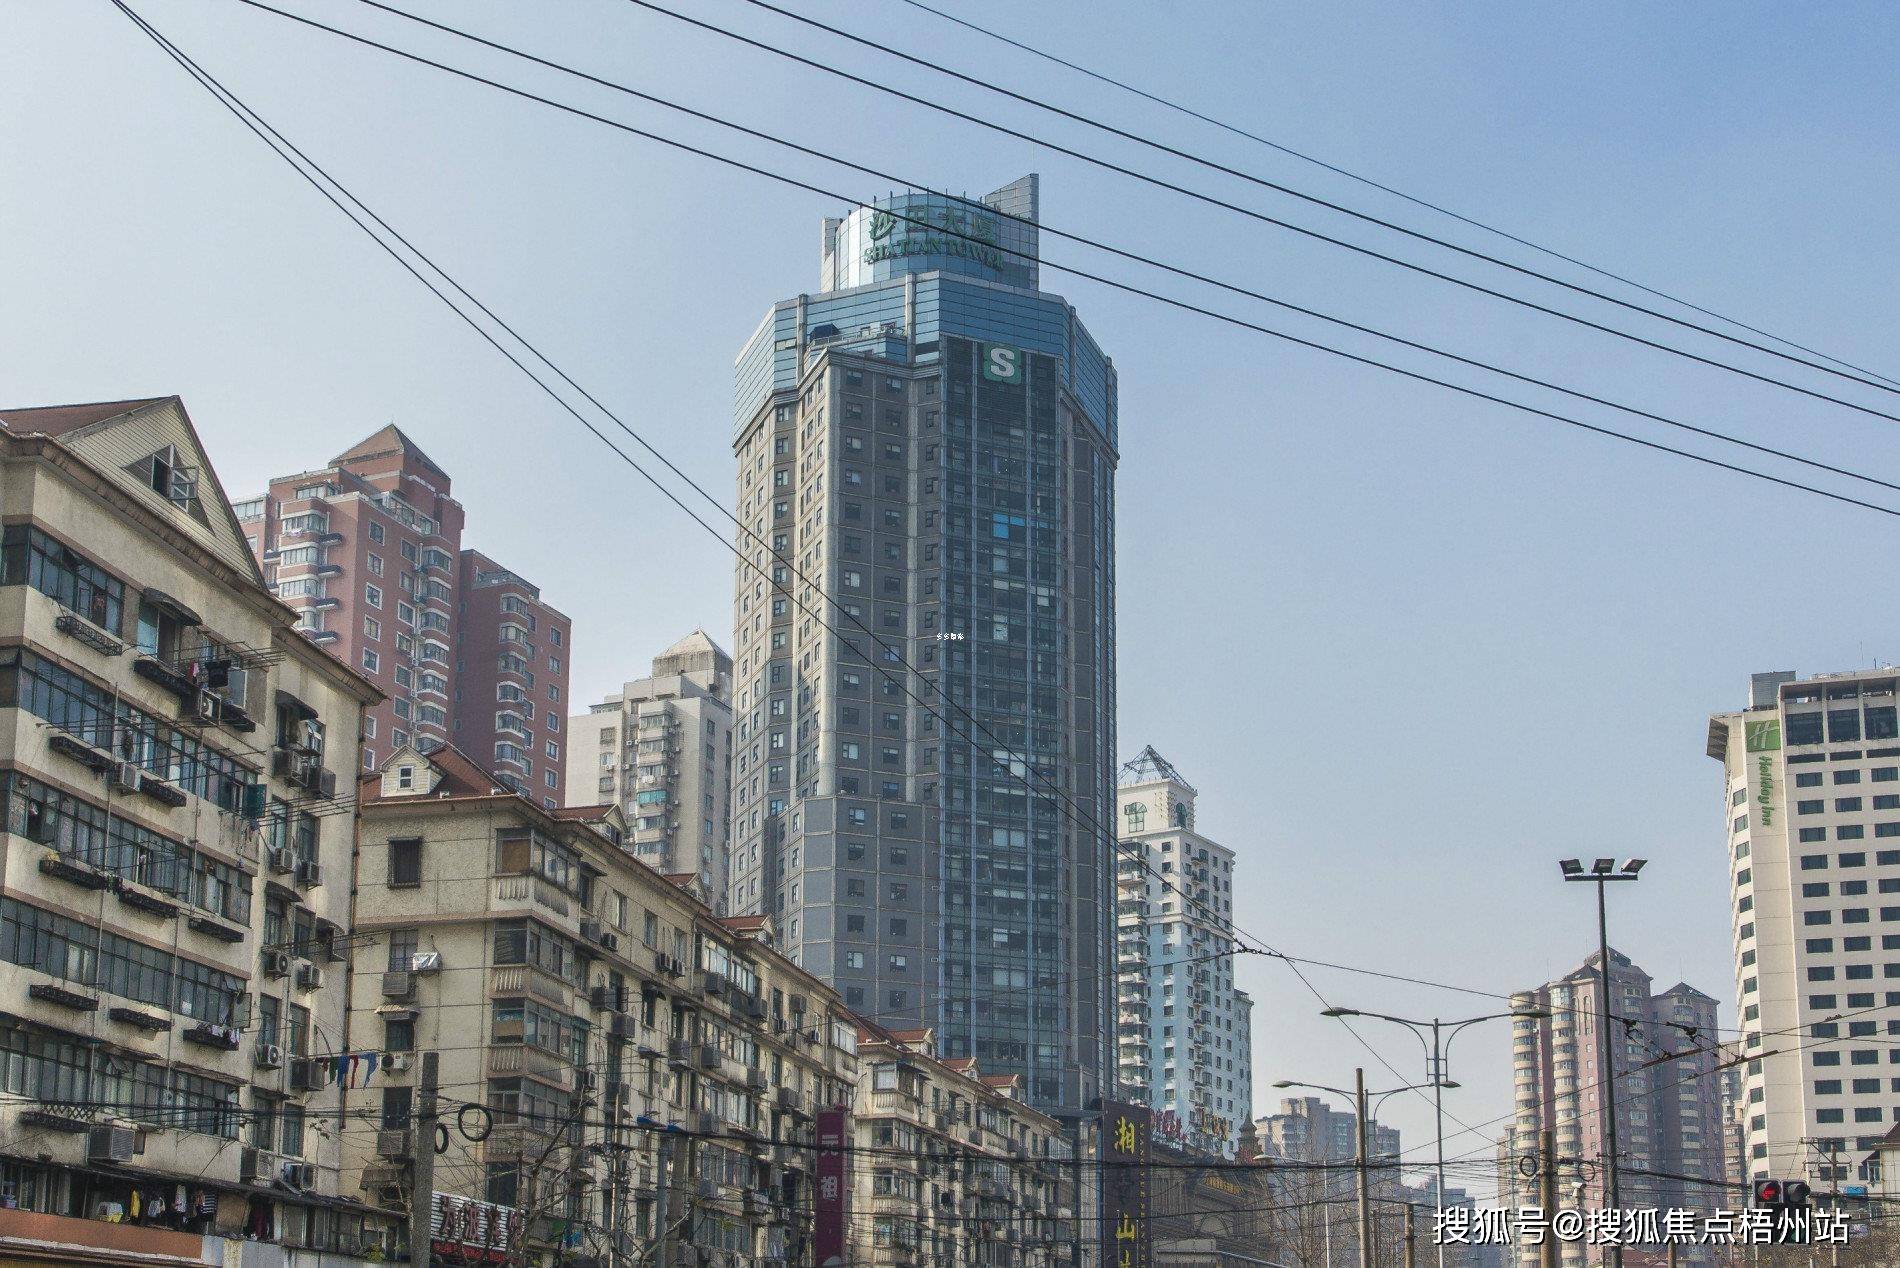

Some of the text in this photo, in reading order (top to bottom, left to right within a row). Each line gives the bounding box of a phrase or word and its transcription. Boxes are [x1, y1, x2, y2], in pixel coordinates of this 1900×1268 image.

[990, 348, 1015, 378] S
[1759, 756, 1774, 825] Holiday Inn
